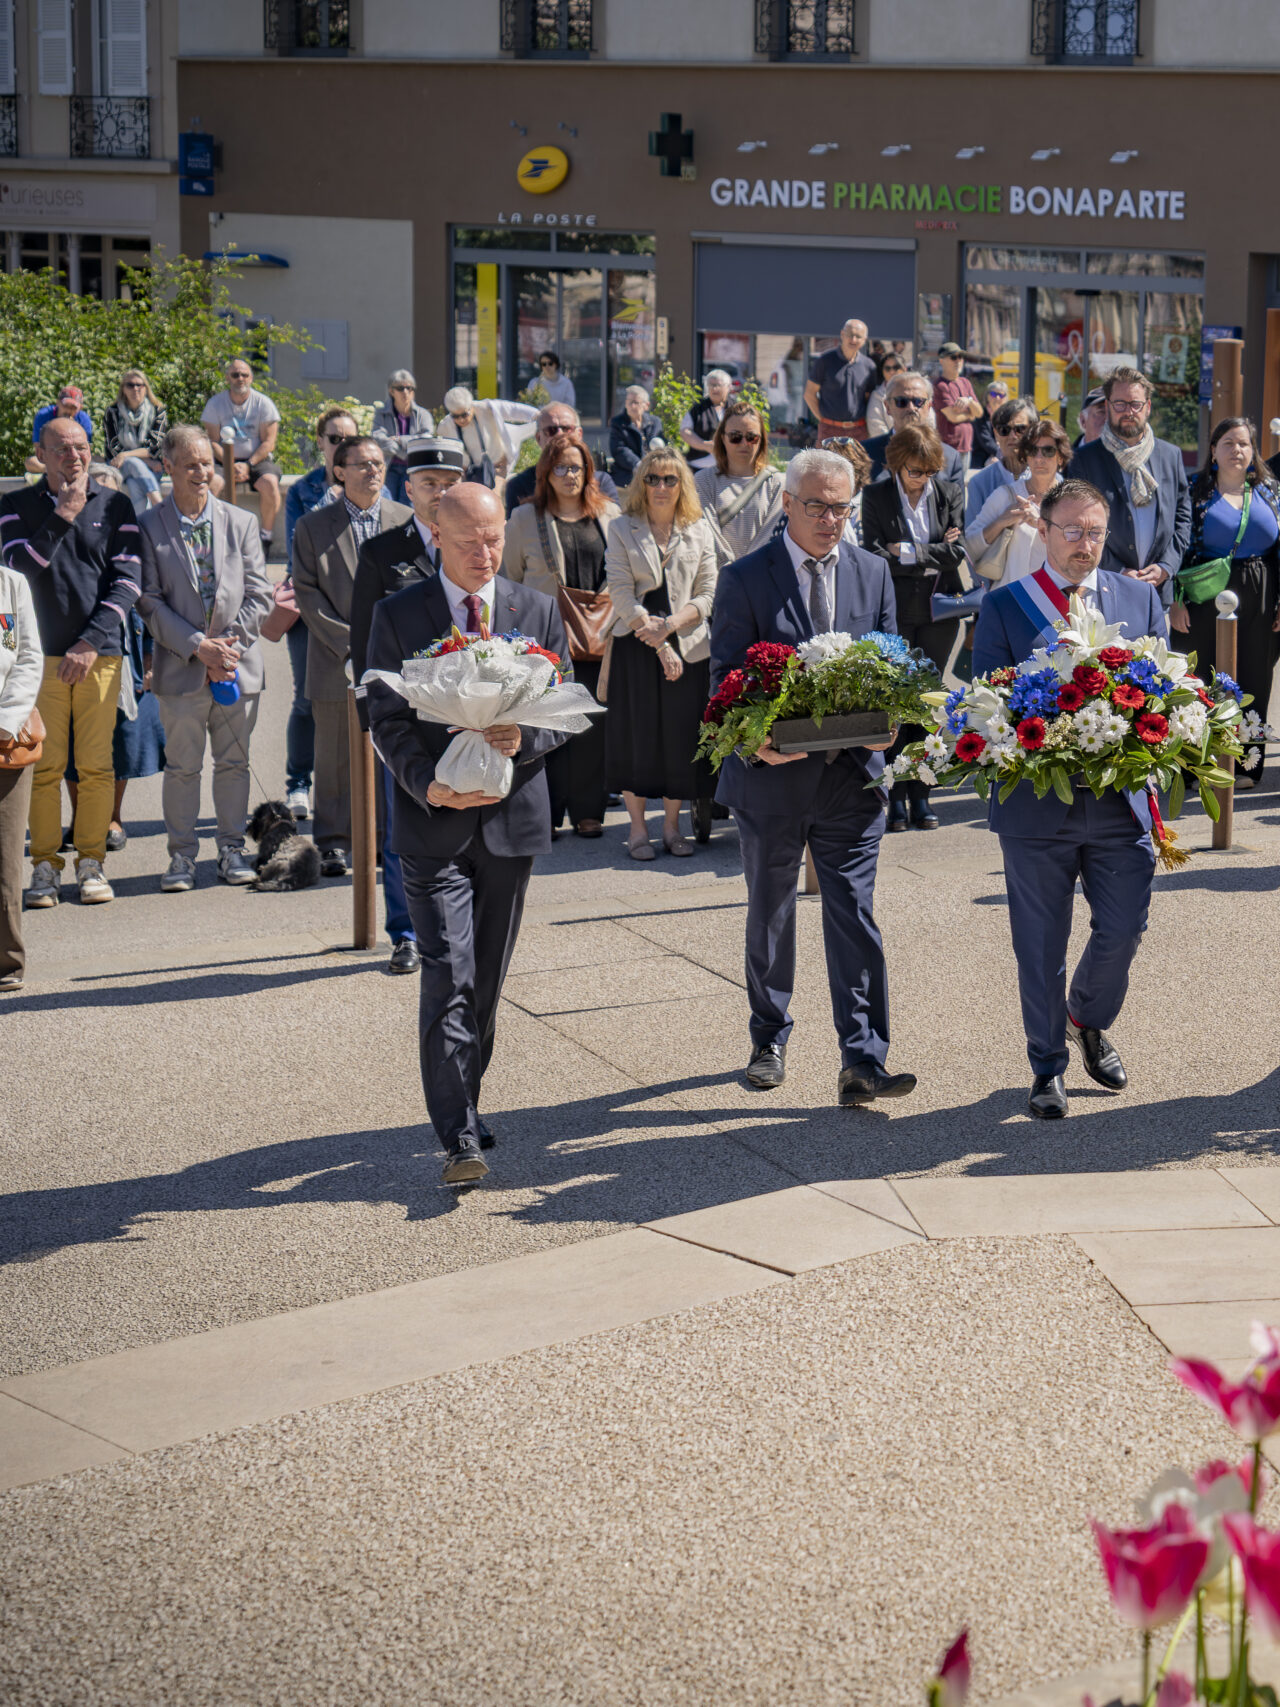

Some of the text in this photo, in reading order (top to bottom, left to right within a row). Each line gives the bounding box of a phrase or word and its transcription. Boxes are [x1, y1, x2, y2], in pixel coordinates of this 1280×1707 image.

[0, 183, 84, 206] urieuses
[710, 177, 1186, 220] GRANDE PHARMACIE BONAPARTE
[498, 212, 597, 227] LA POSTE
